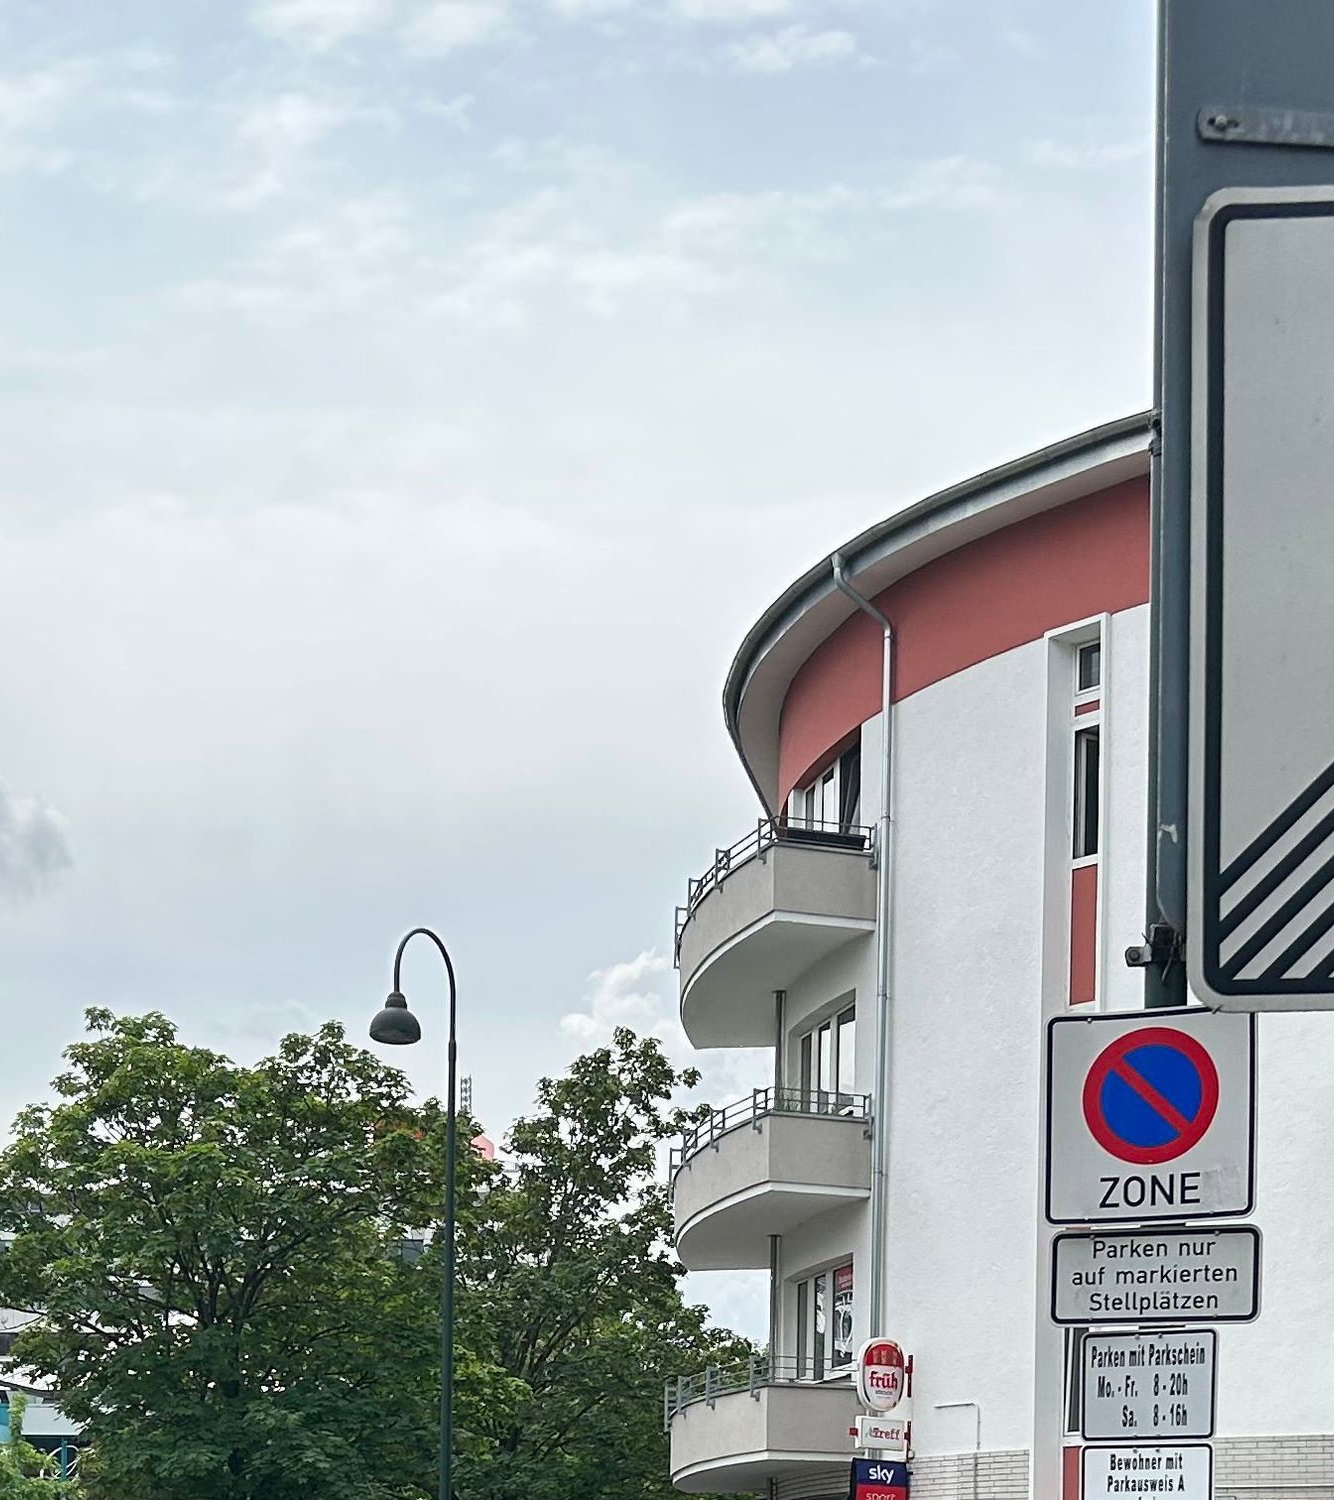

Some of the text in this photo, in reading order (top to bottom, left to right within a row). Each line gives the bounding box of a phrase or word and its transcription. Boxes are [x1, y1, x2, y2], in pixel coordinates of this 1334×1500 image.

[1099, 1172, 1201, 1208] ZONE
[1092, 1239, 1216, 1259] Parken nur
[1072, 1264, 1238, 1285] auf markierten
[1089, 1291, 1219, 1315] Stellplätzen
[1091, 1341, 1206, 1368] Parken mit Parkschein
[1098, 1375, 1115, 1398] Mo.
[1125, 1374, 1138, 1397] Fr.
[1153, 1373, 1159, 1396] 8
[1169, 1372, 1188, 1396] 20h
[1122, 1404, 1137, 1427] Sa.
[1153, 1403, 1159, 1427] 8
[1169, 1403, 1188, 1427] 16h
[1110, 1451, 1183, 1471] Bewohner mit
[869, 1464, 894, 1484] sky
[1107, 1473, 1185, 1493] Parkausweis A
